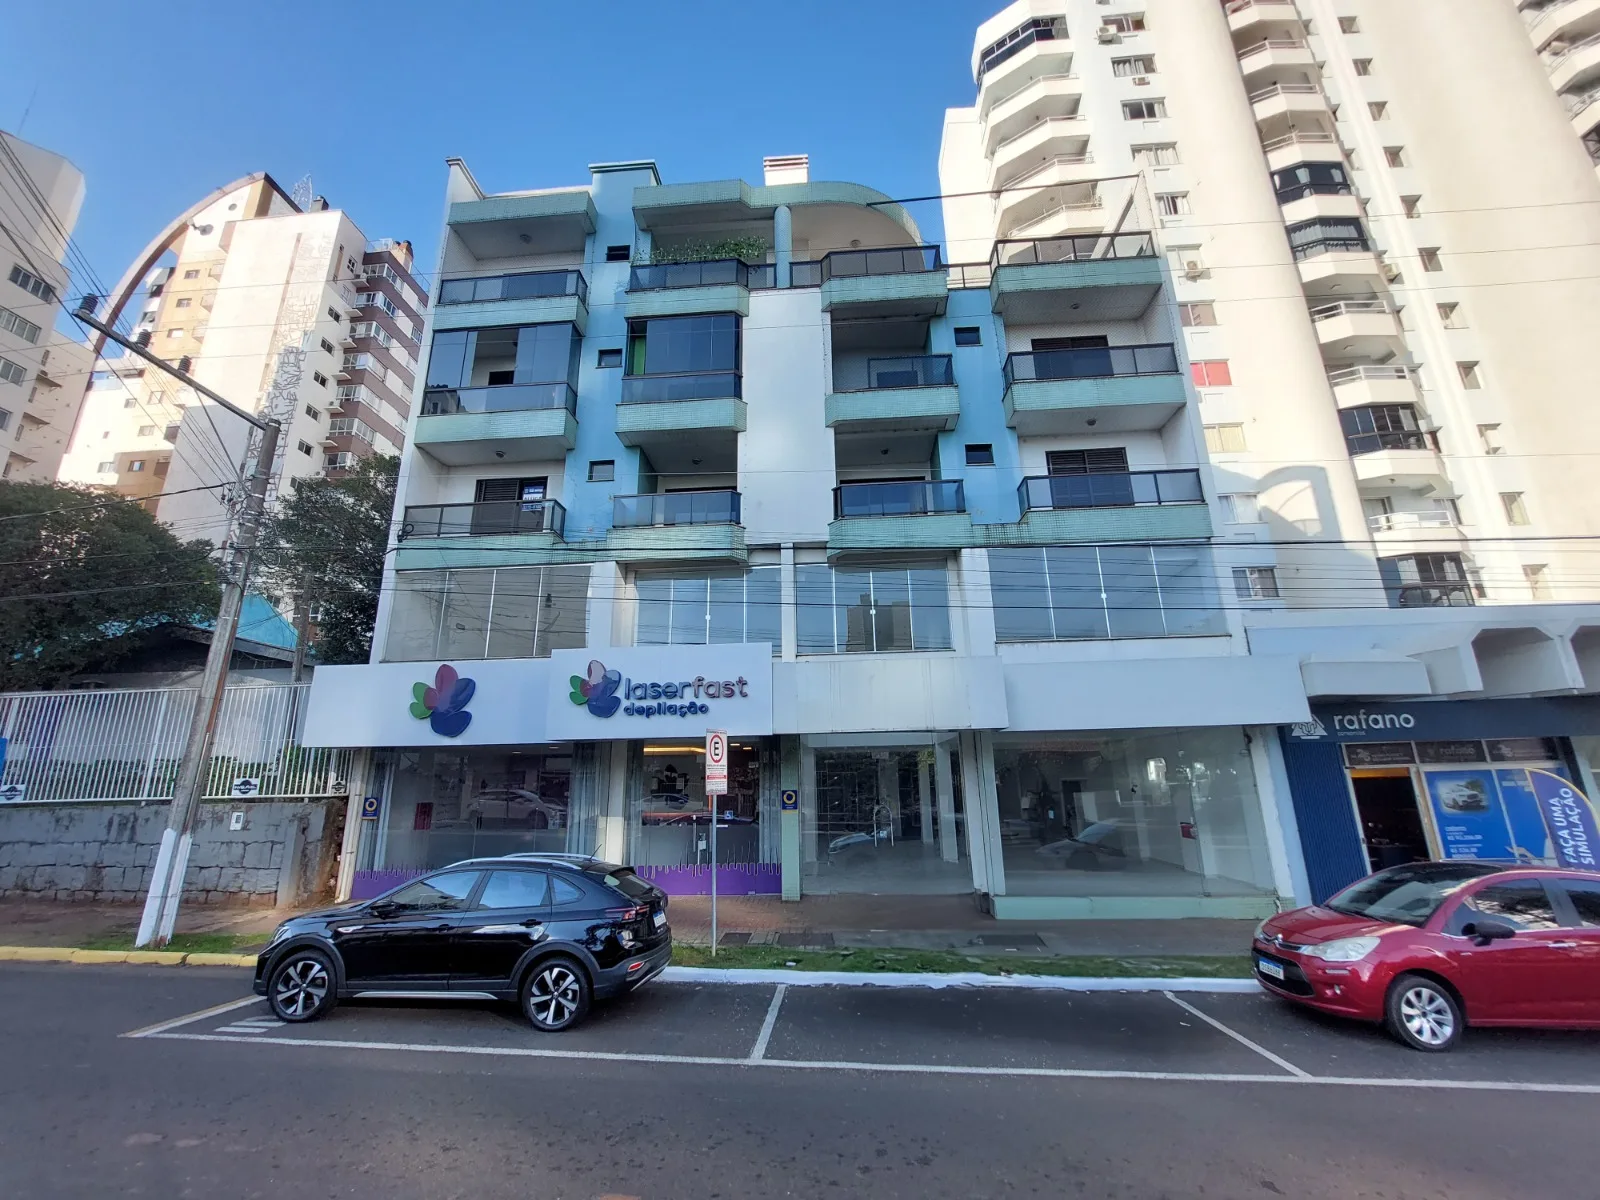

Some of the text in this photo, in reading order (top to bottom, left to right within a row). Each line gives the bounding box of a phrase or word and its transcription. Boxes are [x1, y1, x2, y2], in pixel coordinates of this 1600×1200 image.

[624, 676, 748, 700] laserfast
[623, 701, 710, 718] depilação
[1333, 709, 1415, 730] rafano
[714, 742, 719, 756] E
[1548, 797, 1578, 863] FAÇA UMA
[1560, 787, 1596, 866] SIMULAÇÃO
